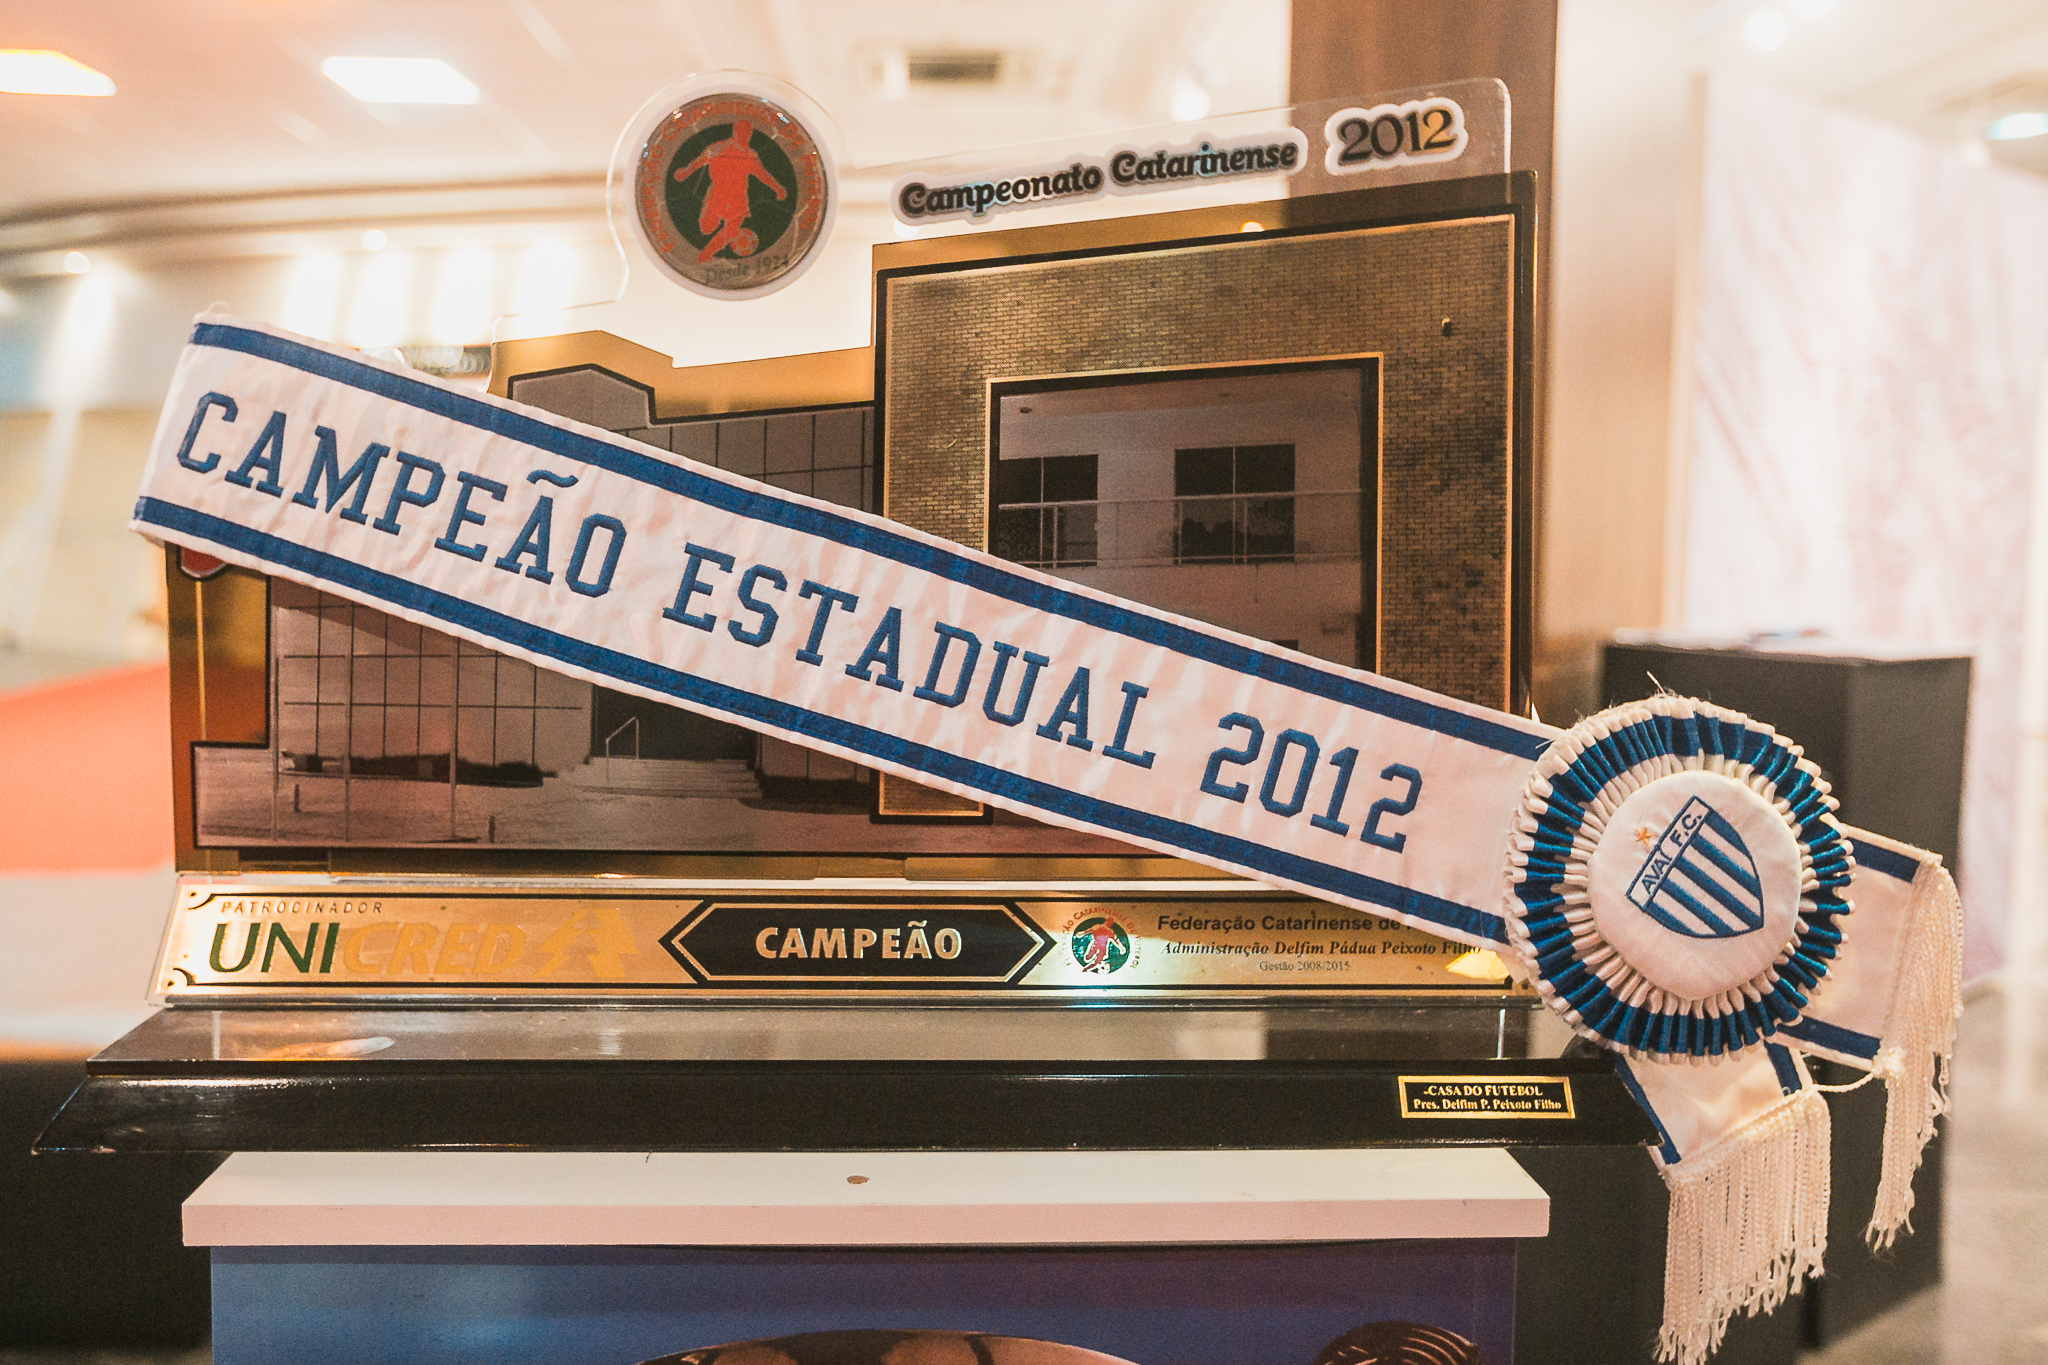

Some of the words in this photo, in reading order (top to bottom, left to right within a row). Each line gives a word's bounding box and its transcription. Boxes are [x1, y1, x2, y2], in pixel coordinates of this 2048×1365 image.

[901, 162, 1102, 214] Campeonato
[1112, 141, 1298, 184] Catarinense
[1337, 107, 1457, 163] 2012
[177, 391, 628, 598] CAMPEÃO
[662, 541, 1157, 769] ESTADUAL
[1200, 712, 1423, 853] 2012
[221, 901, 383, 914] PATROCINADOR
[1157, 915, 1256, 934] Federação
[1261, 913, 1373, 931] Catarinense
[755, 920, 962, 960] CAMPEÃO
[1161, 941, 1270, 957] Administração
[1274, 941, 1324, 957] Delfim
[1329, 941, 1377, 955] Pádua
[1381, 941, 1437, 955] Peixoto
[1259, 960, 1295, 971] Gestão
[1297, 960, 1351, 971] 2008/2015
[1463, 1085, 1482, 1096] DO
[1484, 1085, 1543, 1096] FUTEBOL
[1413, 1098, 1440, 1110] Pres.
[1442, 1098, 1478, 1110] Delfim
[1480, 1098, 1491, 1110] P.
[1493, 1098, 1532, 1110] Peixoto
[1534, 1098, 1562, 1110] Filho
